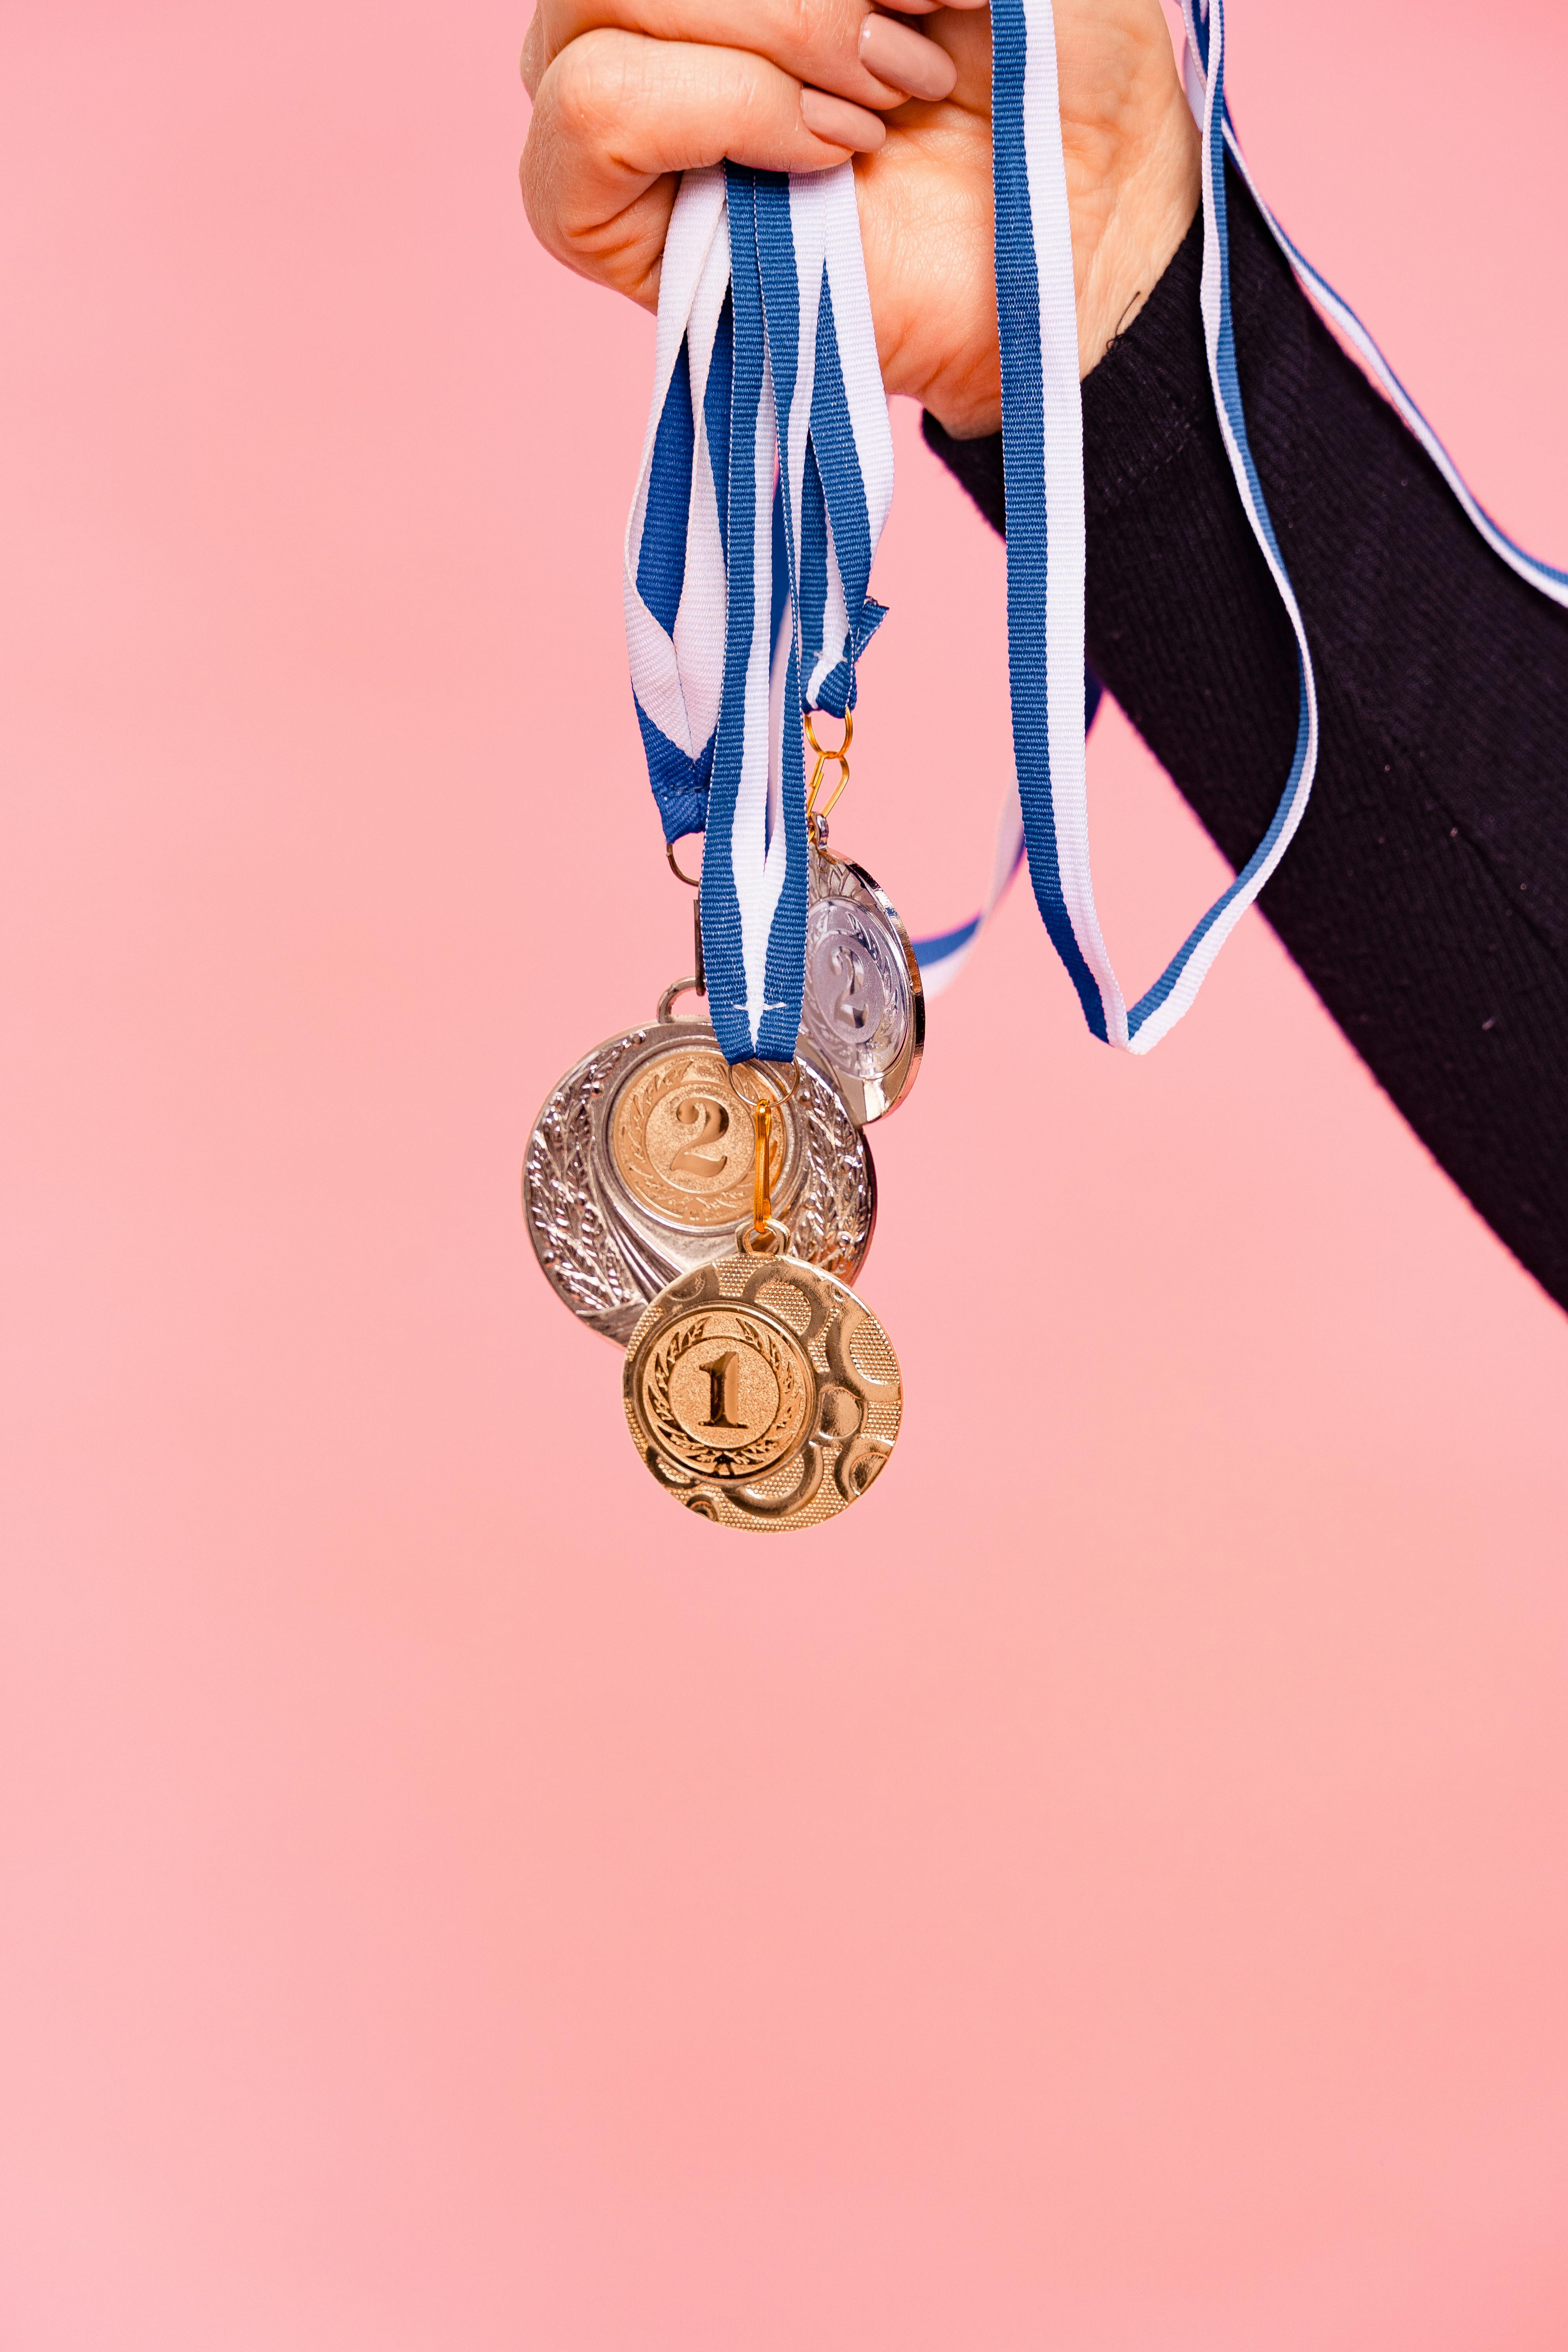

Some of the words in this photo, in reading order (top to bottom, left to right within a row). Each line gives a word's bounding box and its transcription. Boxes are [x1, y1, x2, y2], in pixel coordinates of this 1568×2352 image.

[830, 946, 869, 1029] 2
[669, 1097, 729, 1176] 2
[699, 1351, 748, 1429] 1
